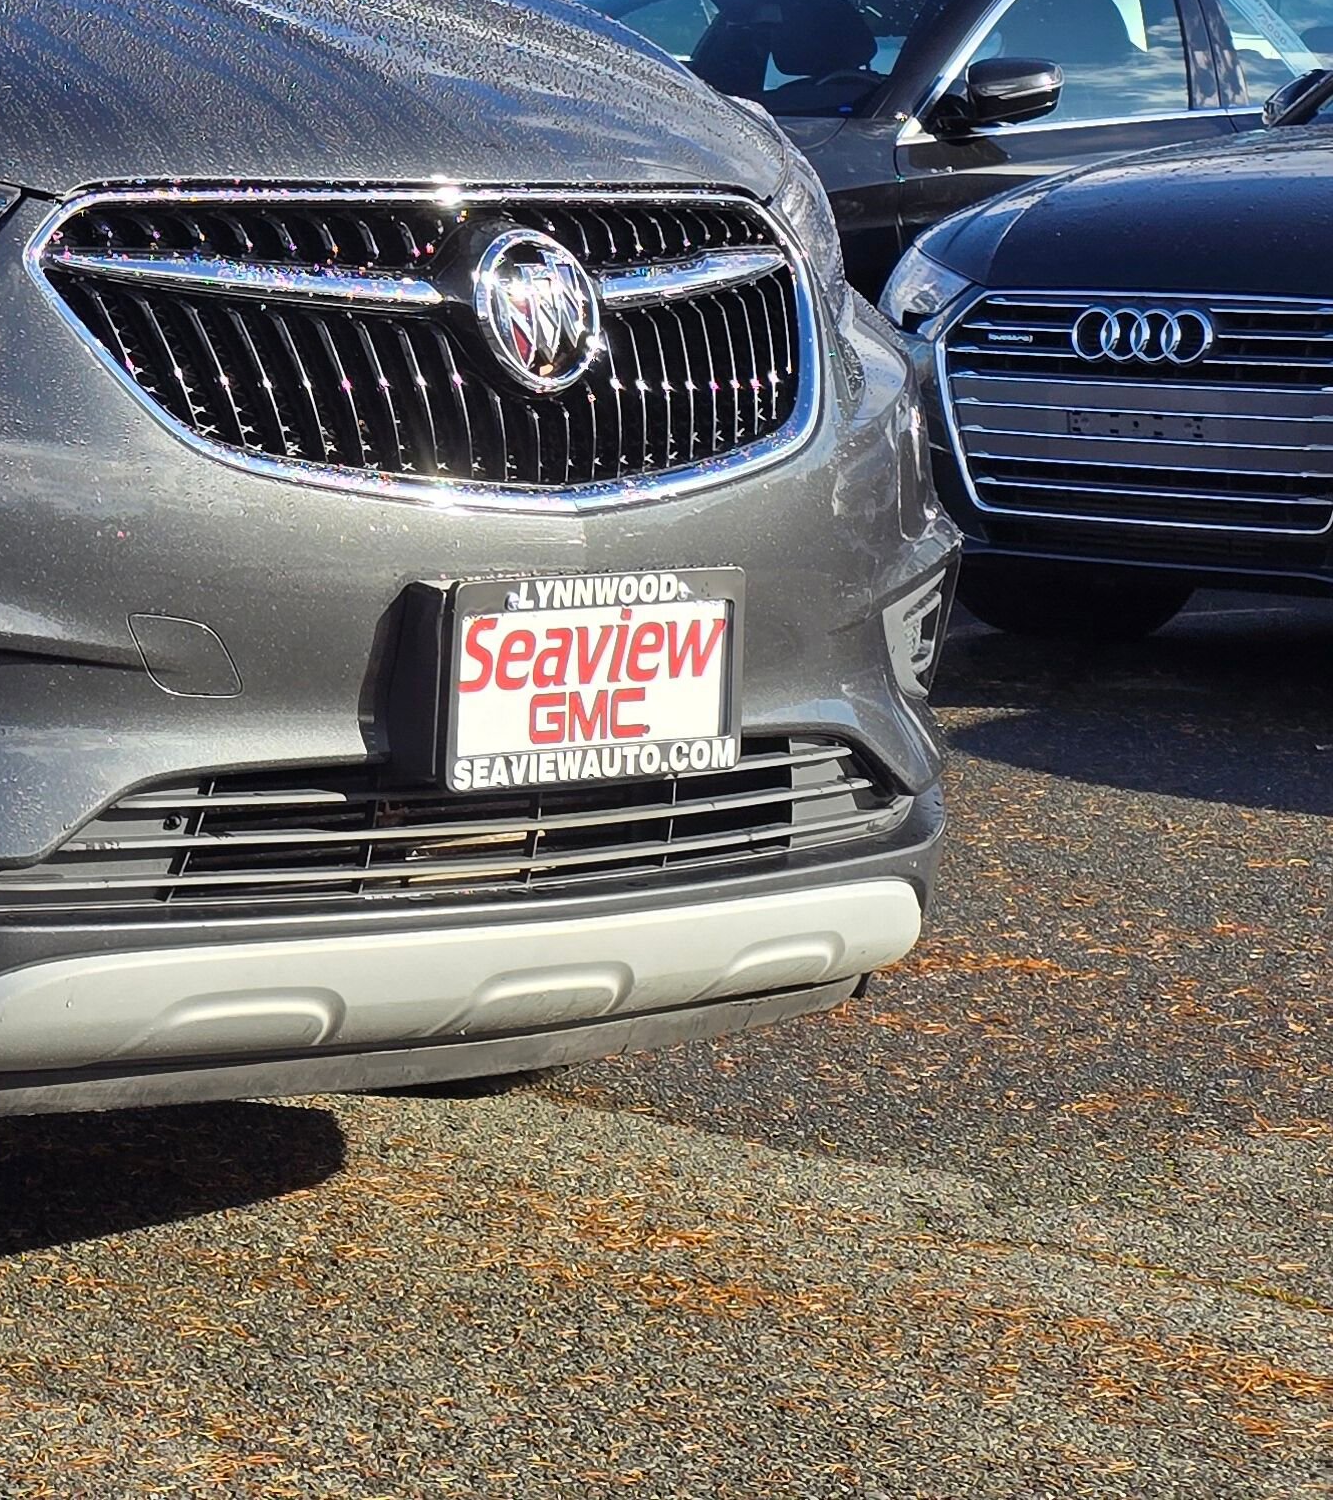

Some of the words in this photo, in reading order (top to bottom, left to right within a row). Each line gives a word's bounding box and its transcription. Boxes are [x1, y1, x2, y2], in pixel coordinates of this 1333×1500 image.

[518, 574, 679, 609] LYNNWOOD
[459, 609, 726, 692] Seaview
[529, 688, 649, 745] GMC
[452, 741, 735, 791] SEAVIEWAUTO.COM
